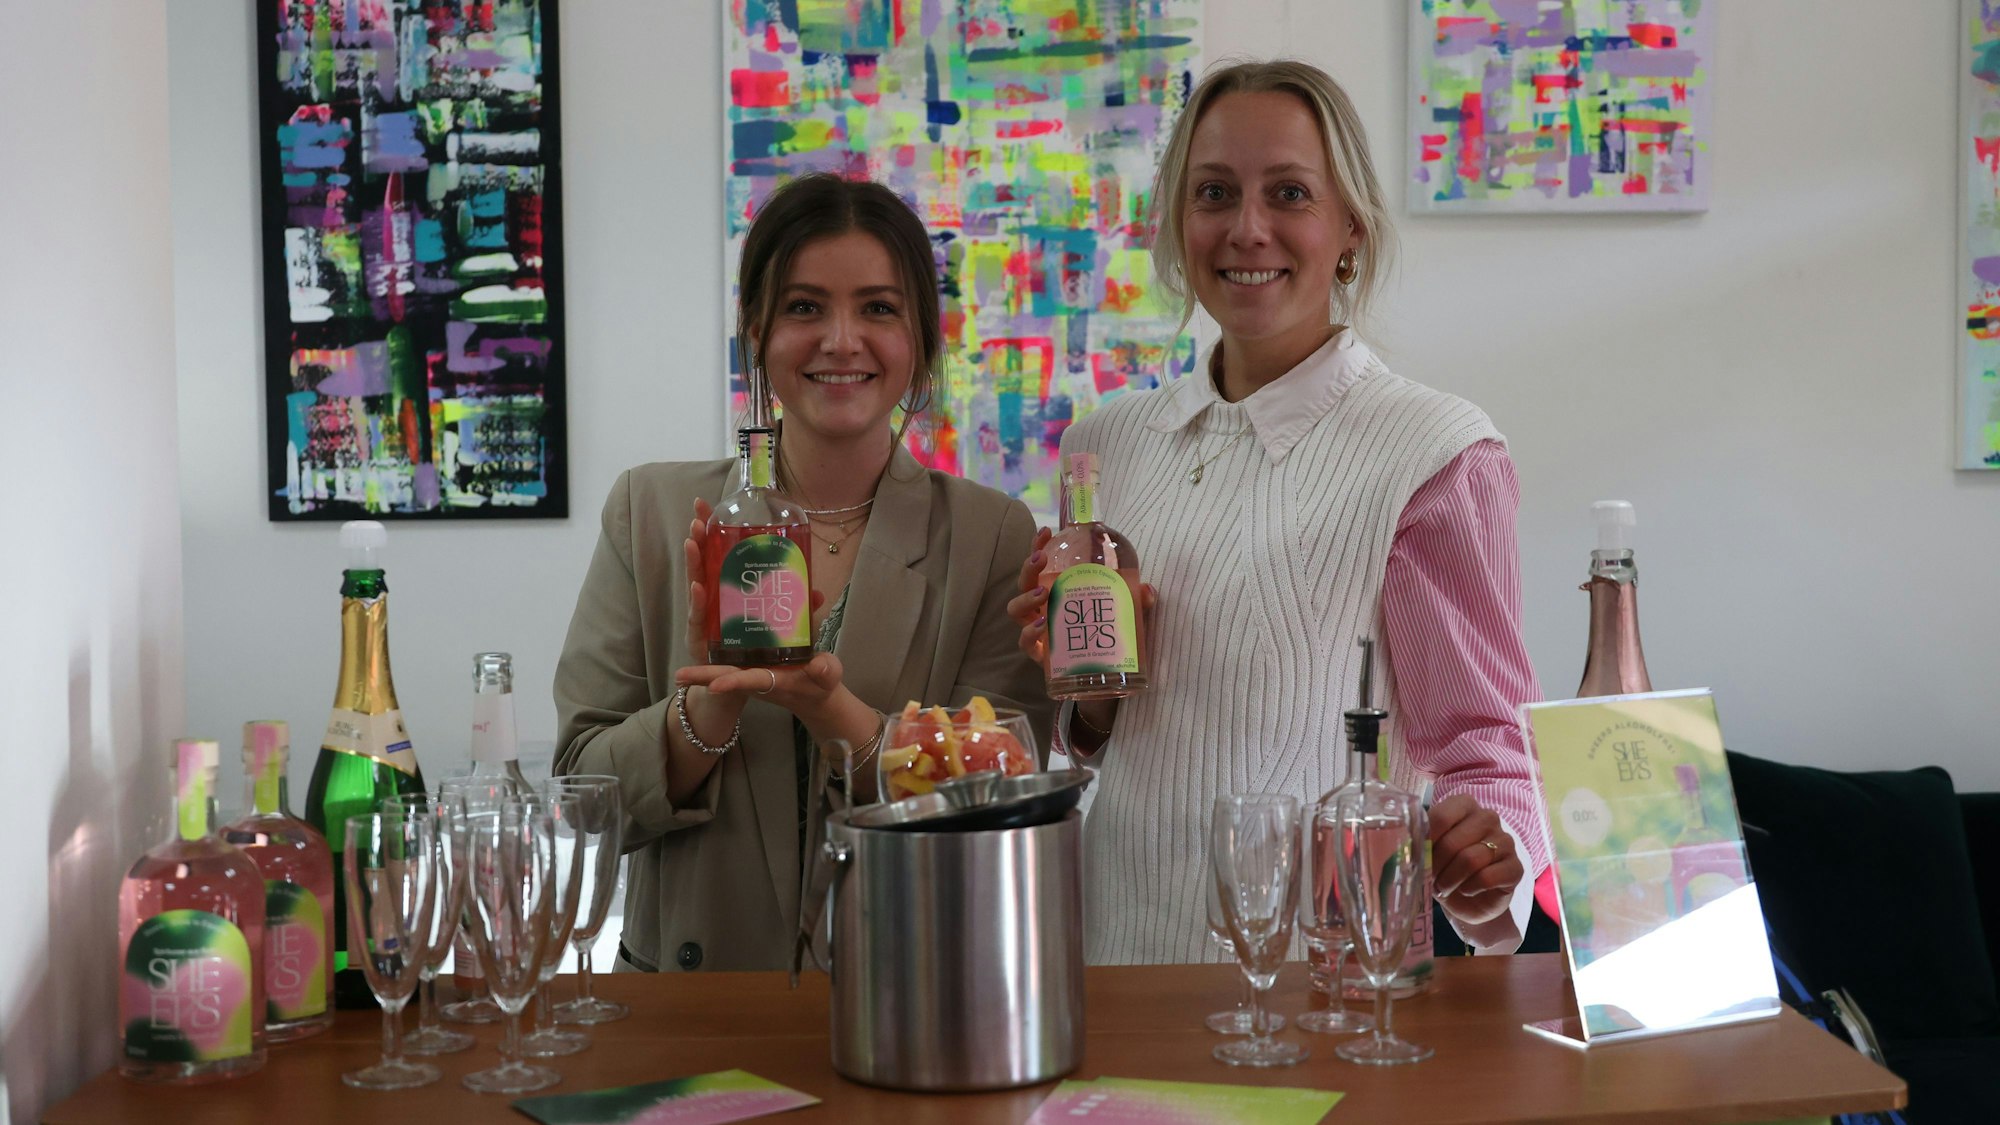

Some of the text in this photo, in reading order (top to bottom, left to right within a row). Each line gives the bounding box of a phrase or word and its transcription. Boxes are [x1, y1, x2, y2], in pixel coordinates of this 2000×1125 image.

[740, 570, 793, 596] SHE
[742, 596, 793, 624] ERS
[1063, 598, 1116, 625] SHE
[1065, 623, 1116, 652] ERS
[148, 957, 222, 993] SHE
